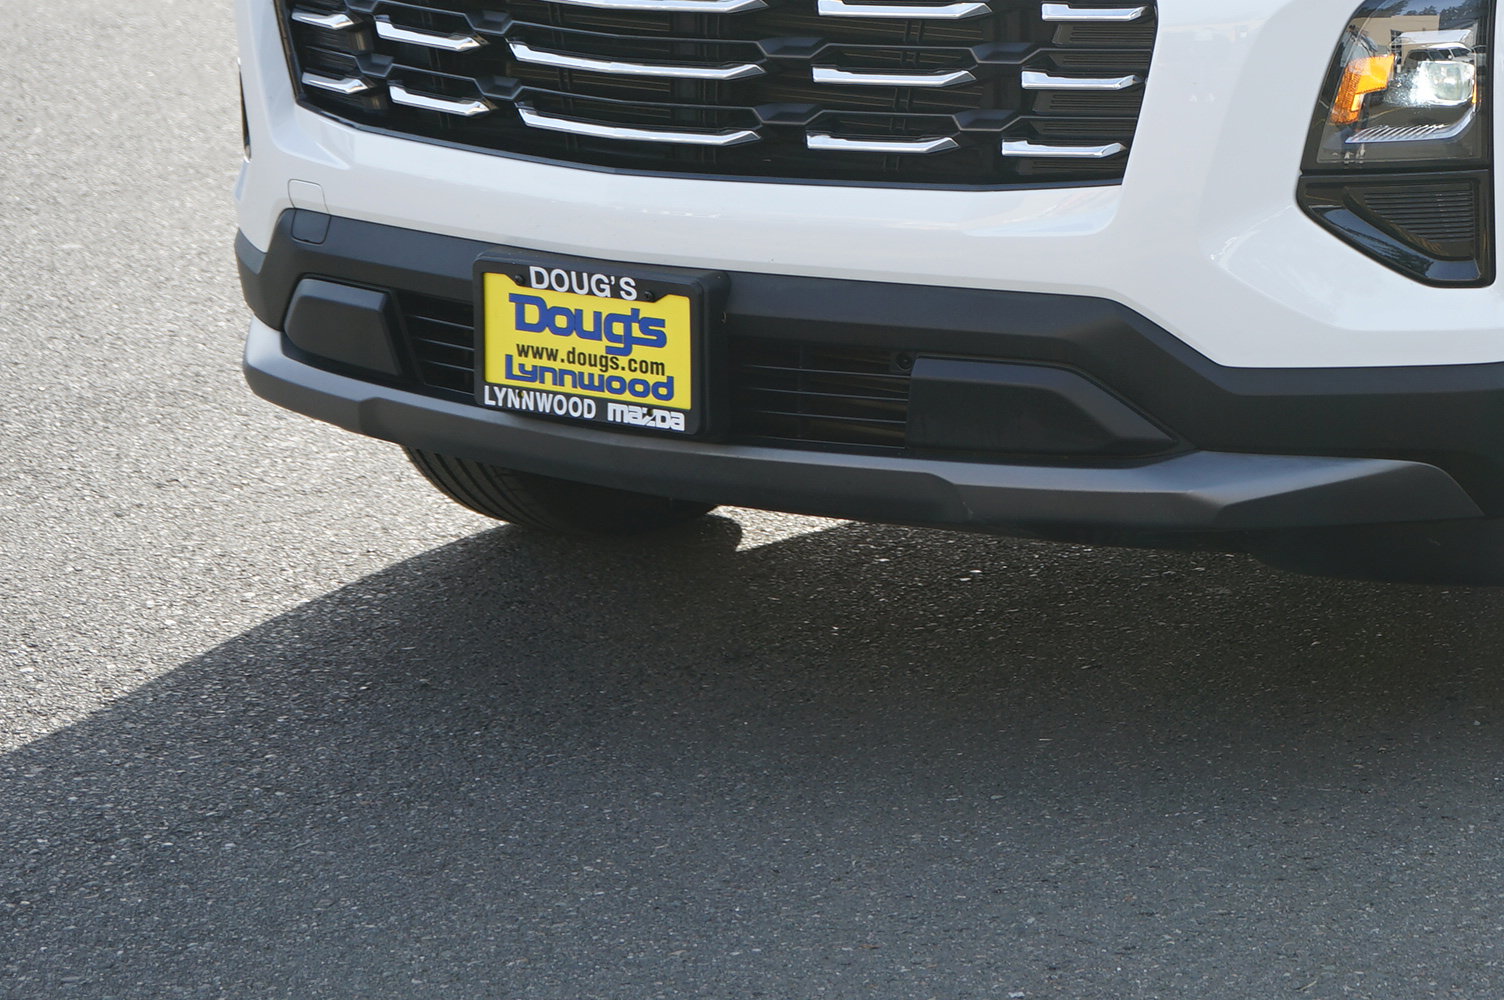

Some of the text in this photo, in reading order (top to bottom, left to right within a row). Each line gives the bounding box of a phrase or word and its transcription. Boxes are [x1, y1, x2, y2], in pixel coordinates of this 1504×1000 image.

[529, 266, 638, 301] DOUG'S
[508, 292, 668, 357] Doug's
[516, 343, 666, 376] www.dougs.com
[505, 354, 675, 401] Lynnwood
[484, 385, 597, 419] LYNNWOOD
